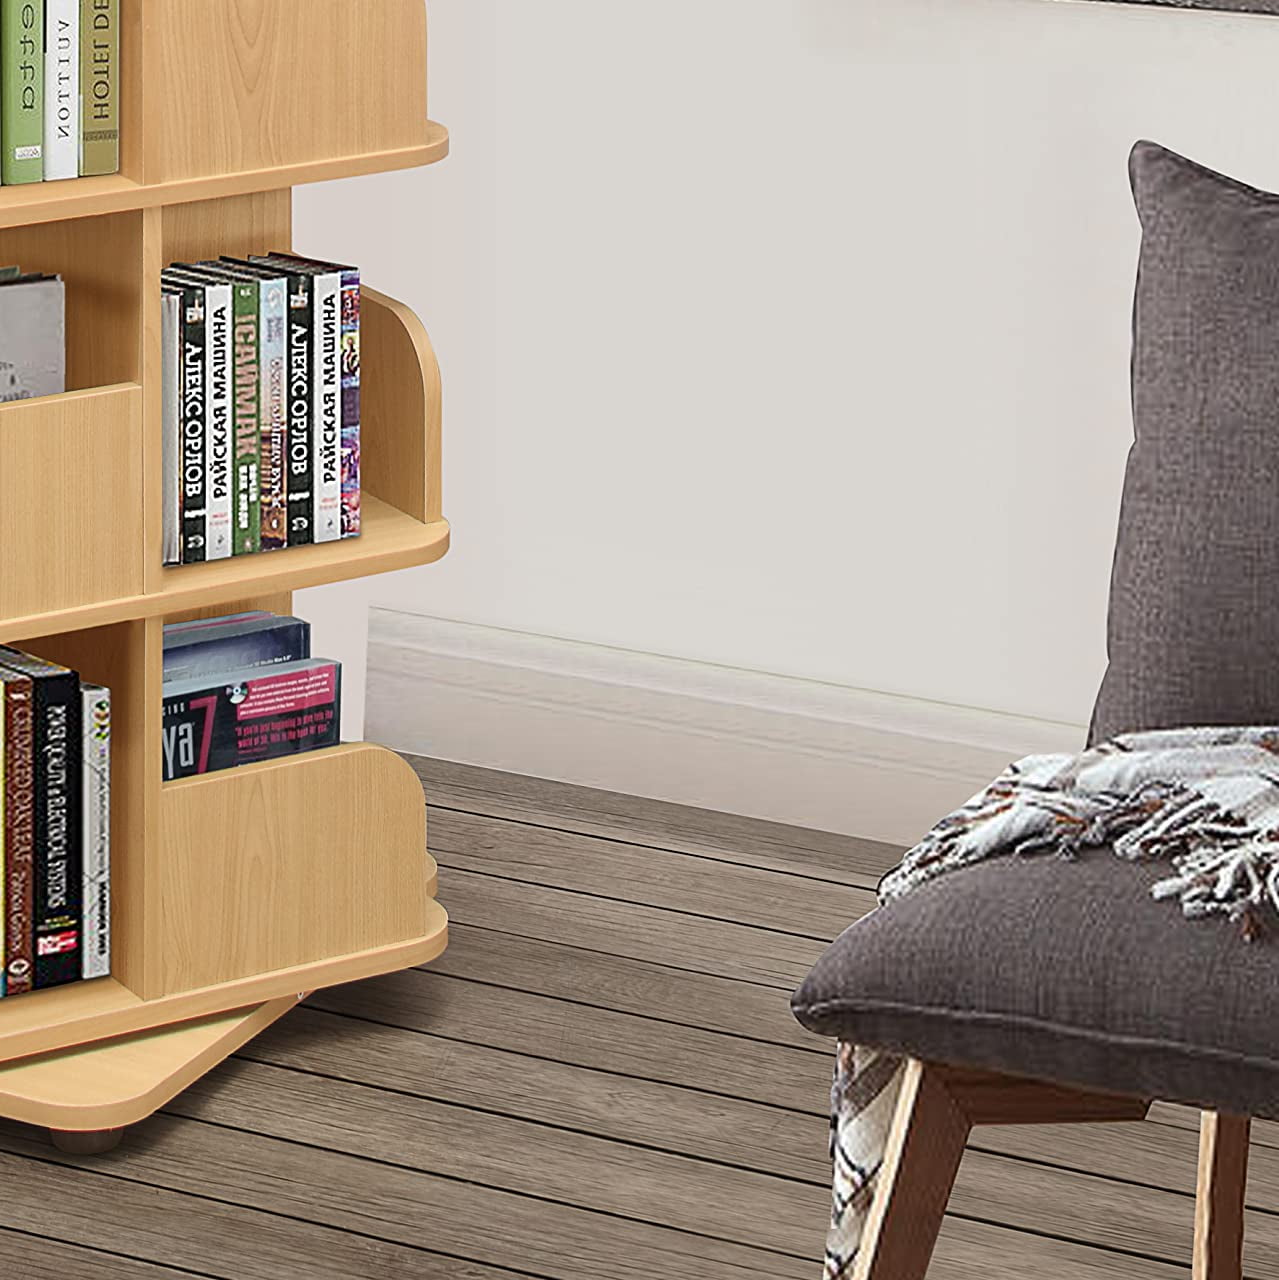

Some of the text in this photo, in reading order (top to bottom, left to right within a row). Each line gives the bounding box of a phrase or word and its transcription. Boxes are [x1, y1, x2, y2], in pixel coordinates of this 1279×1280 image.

[213, 306, 227, 400] МАШИНА
[323, 294, 336, 385] МАШИНА
[186, 342, 204, 498] АЛЕКС ОРЛОВ
[291, 323, 309, 476] АЛЕКС ОРЛОВ
[320, 392, 336, 484] РАЙСКАЯ
[210, 406, 227, 499] РАЙСКАЯ
[163, 722, 195, 779] ya
[189, 695, 218, 774] 7
